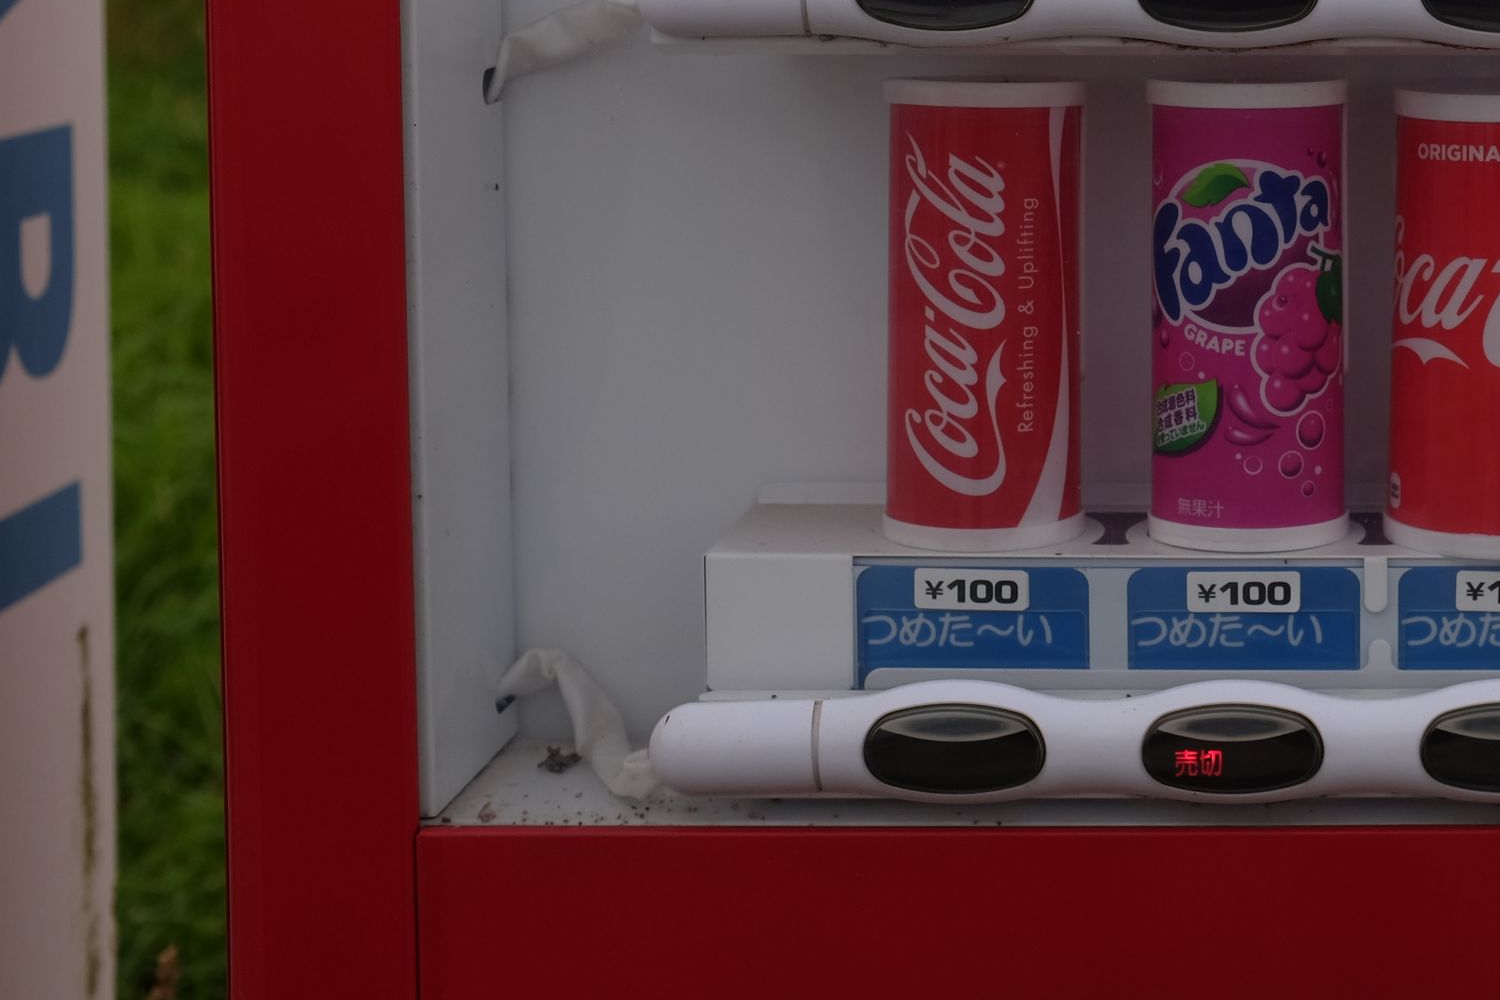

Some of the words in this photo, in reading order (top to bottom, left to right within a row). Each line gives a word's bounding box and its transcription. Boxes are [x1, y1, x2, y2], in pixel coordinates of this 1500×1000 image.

[1017, 198, 1039, 289] Uplifting
[1153, 171, 1328, 322] Fanta
[905, 130, 1006, 496] Coca-Cola
[1018, 299, 1034, 315] &
[1183, 324, 1246, 356] GRAPE
[1017, 326, 1039, 432] Refreshing
[1178, 498, 1224, 519] 無果汁
[924, 579, 1019, 604] ¥100
[1198, 581, 1291, 606] ¥100
[1174, 749, 1224, 777] 売切
